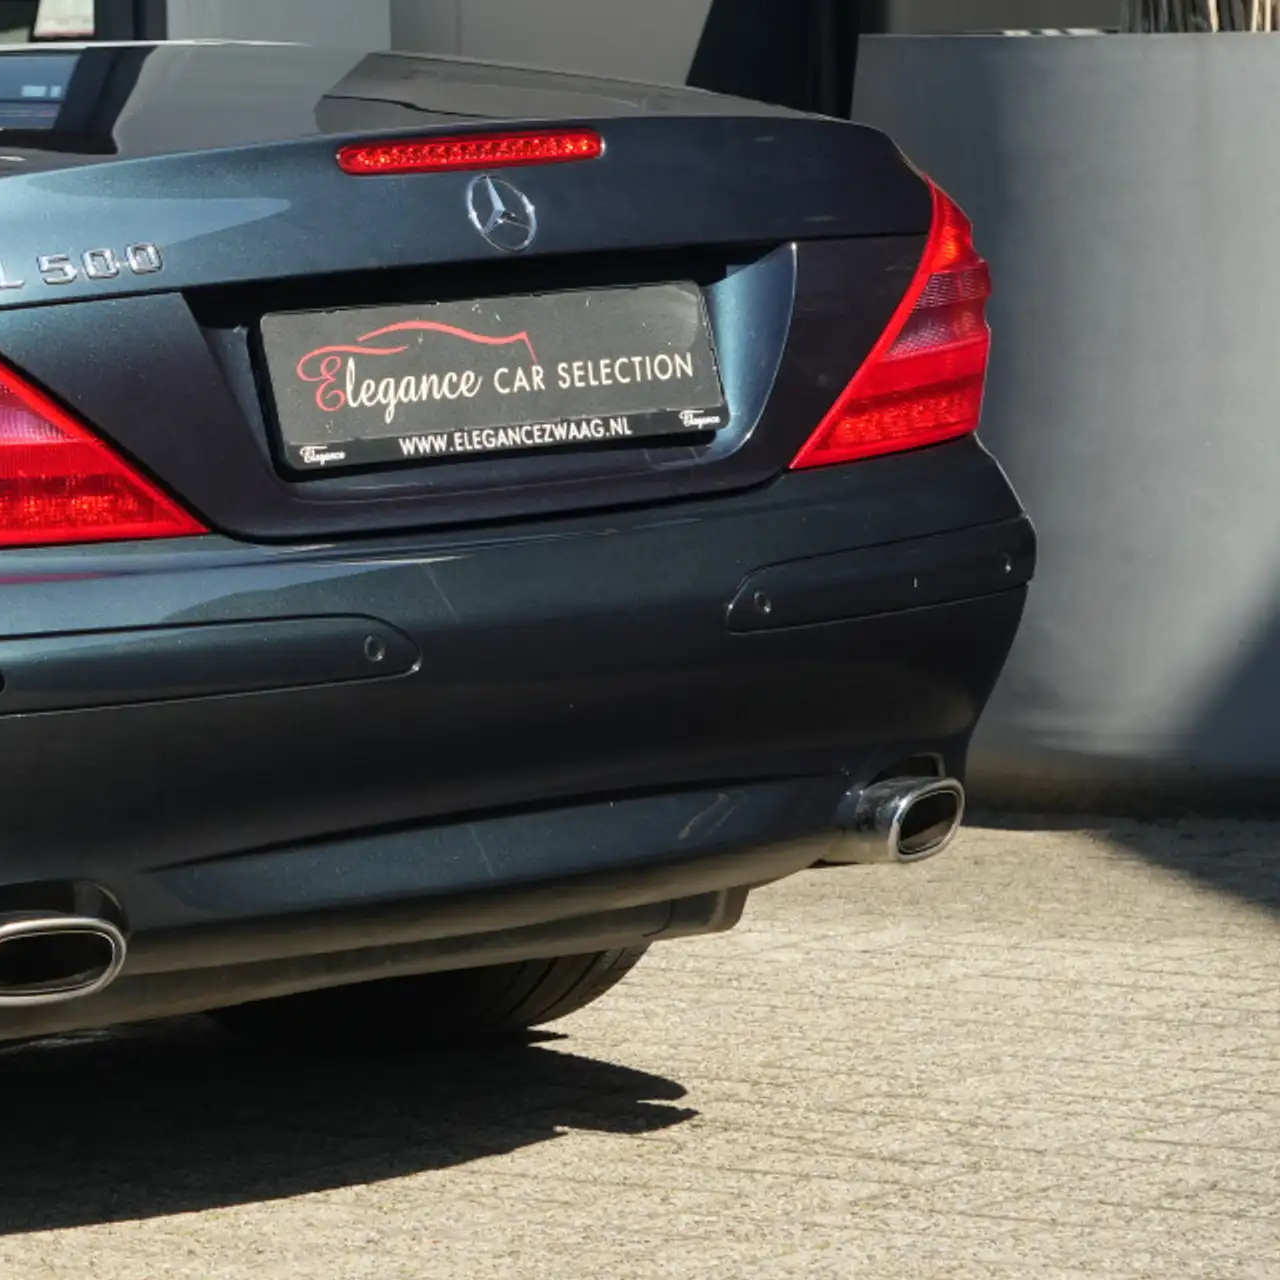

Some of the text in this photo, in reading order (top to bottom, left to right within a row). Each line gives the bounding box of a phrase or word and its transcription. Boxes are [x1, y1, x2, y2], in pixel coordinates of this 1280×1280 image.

[35, 241, 164, 286] 500
[297, 351, 695, 423] Elegance CAR SELECTION
[397, 415, 634, 457] WWW.ELEGANCEZWAAG.NL
